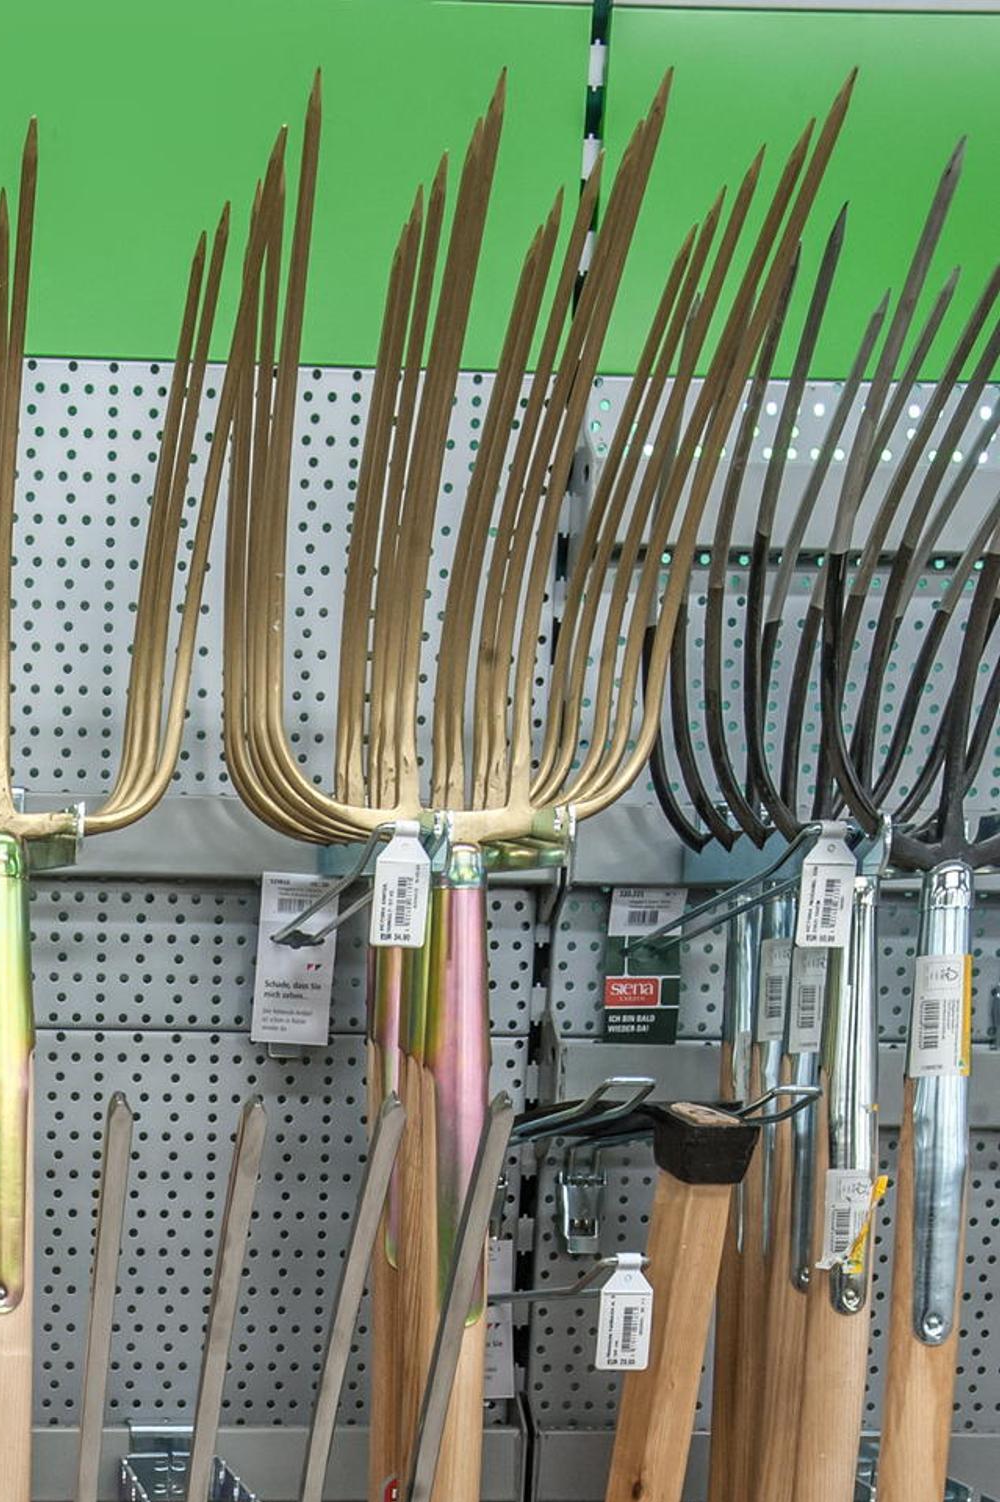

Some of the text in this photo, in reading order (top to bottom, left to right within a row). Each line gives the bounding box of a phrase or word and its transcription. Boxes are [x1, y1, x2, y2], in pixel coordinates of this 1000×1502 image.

[610, 982, 654, 996] siena
[622, 1014, 636, 1022] BIN
[636, 1014, 656, 1022] BALD
[607, 1024, 635, 1033] WIEDER
